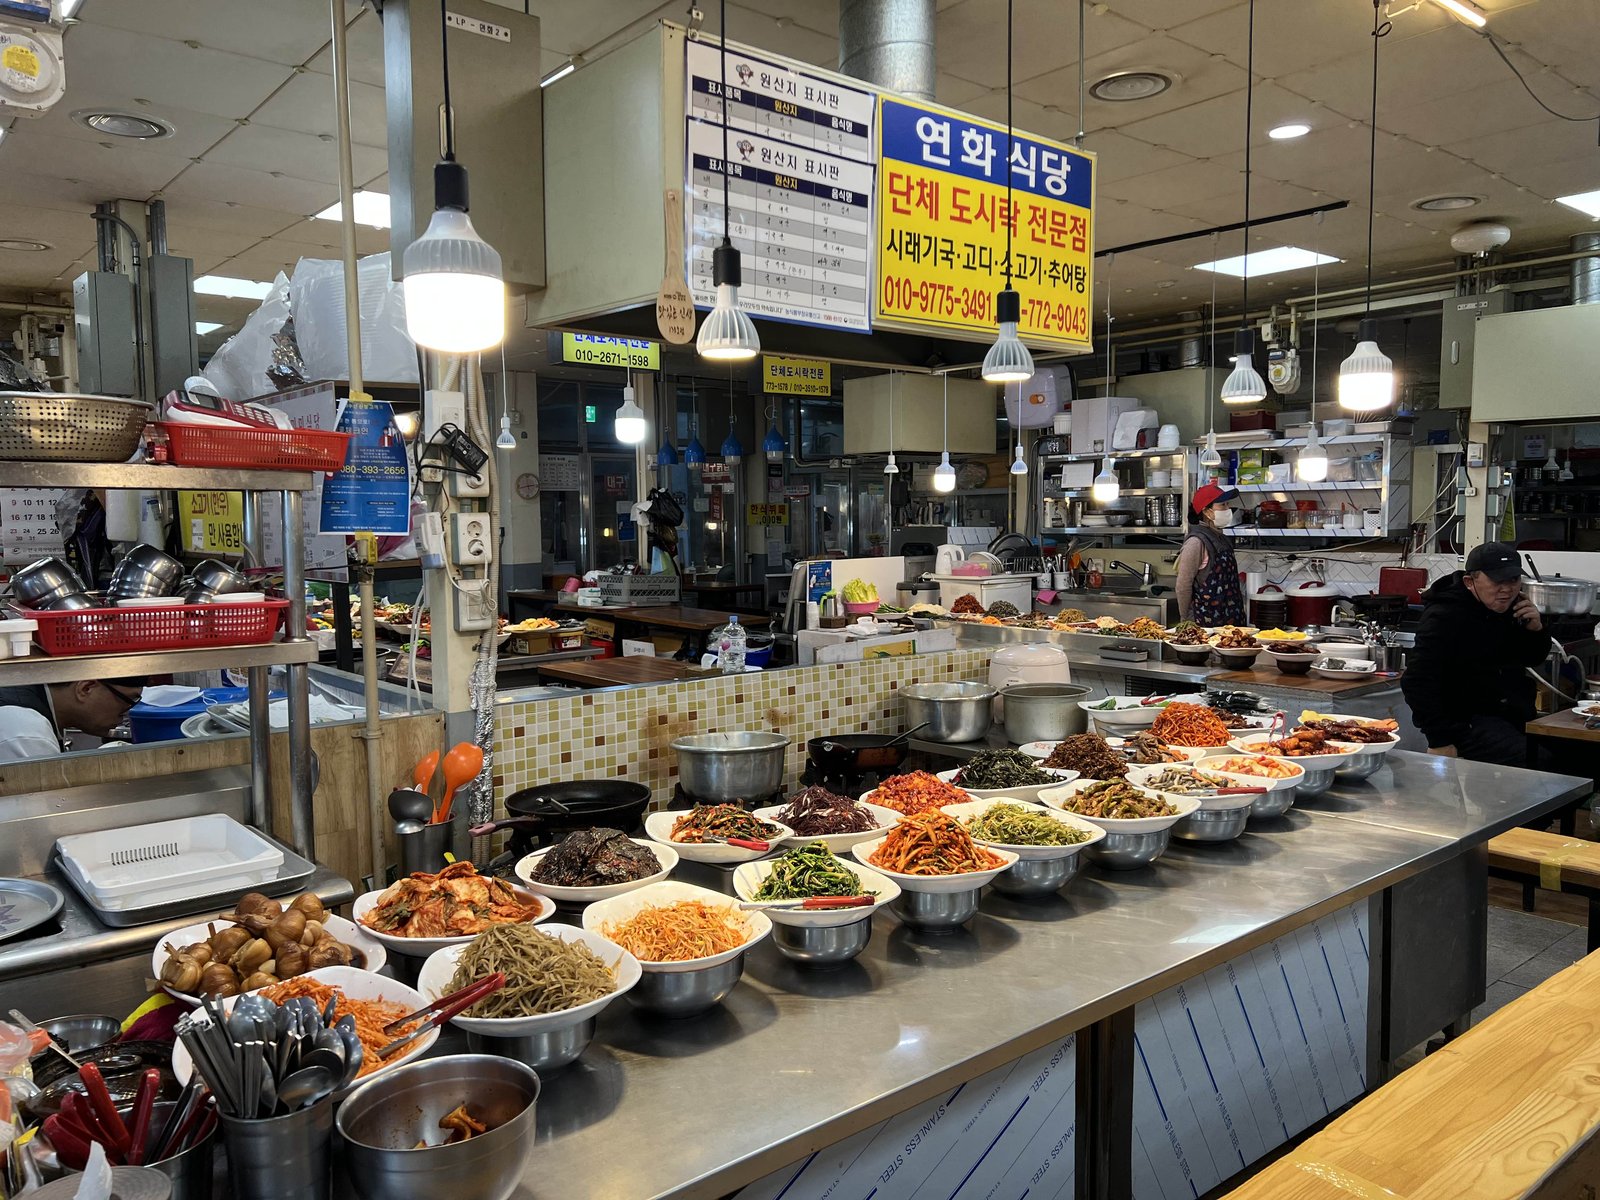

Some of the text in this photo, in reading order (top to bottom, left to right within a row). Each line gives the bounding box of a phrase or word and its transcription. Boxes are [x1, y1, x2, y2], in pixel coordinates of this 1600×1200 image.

[456, 17, 466, 26] LP
[495, 28, 500, 37] 2
[760, 72, 839, 110] 원산지 표시판
[774, 100, 798, 116] 원산지
[831, 116, 853, 133] 음식명
[760, 147, 839, 181] 원산지 표시판
[915, 116, 1071, 196] 연화 식당
[774, 174, 798, 190] 원산지
[831, 187, 853, 203] 음식명
[888, 171, 939, 221] 단체
[949, 186, 1021, 238] 도시락
[1027, 203, 1087, 254] 전문점
[1021, 298, 1087, 336] -772-9043
[575, 349, 649, 367] 010-2671-1598
[770, 365, 824, 380] 단체도시락전문
[208, 522, 243, 548] 만 사용합
[1226, 963, 1237, 986] STEEL
[1177, 985, 1188, 1010] STEEL
[1032, 1032, 1076, 1093] AINLESS STEEL
[1215, 1092, 1241, 1151] STAINLESS STEEL
[879, 1104, 947, 1185] STAINLESS STEEL
[1032, 1122, 1076, 1185] AINLESS STEEL
[1164, 1120, 1193, 1182] STAINLESS STEEL
